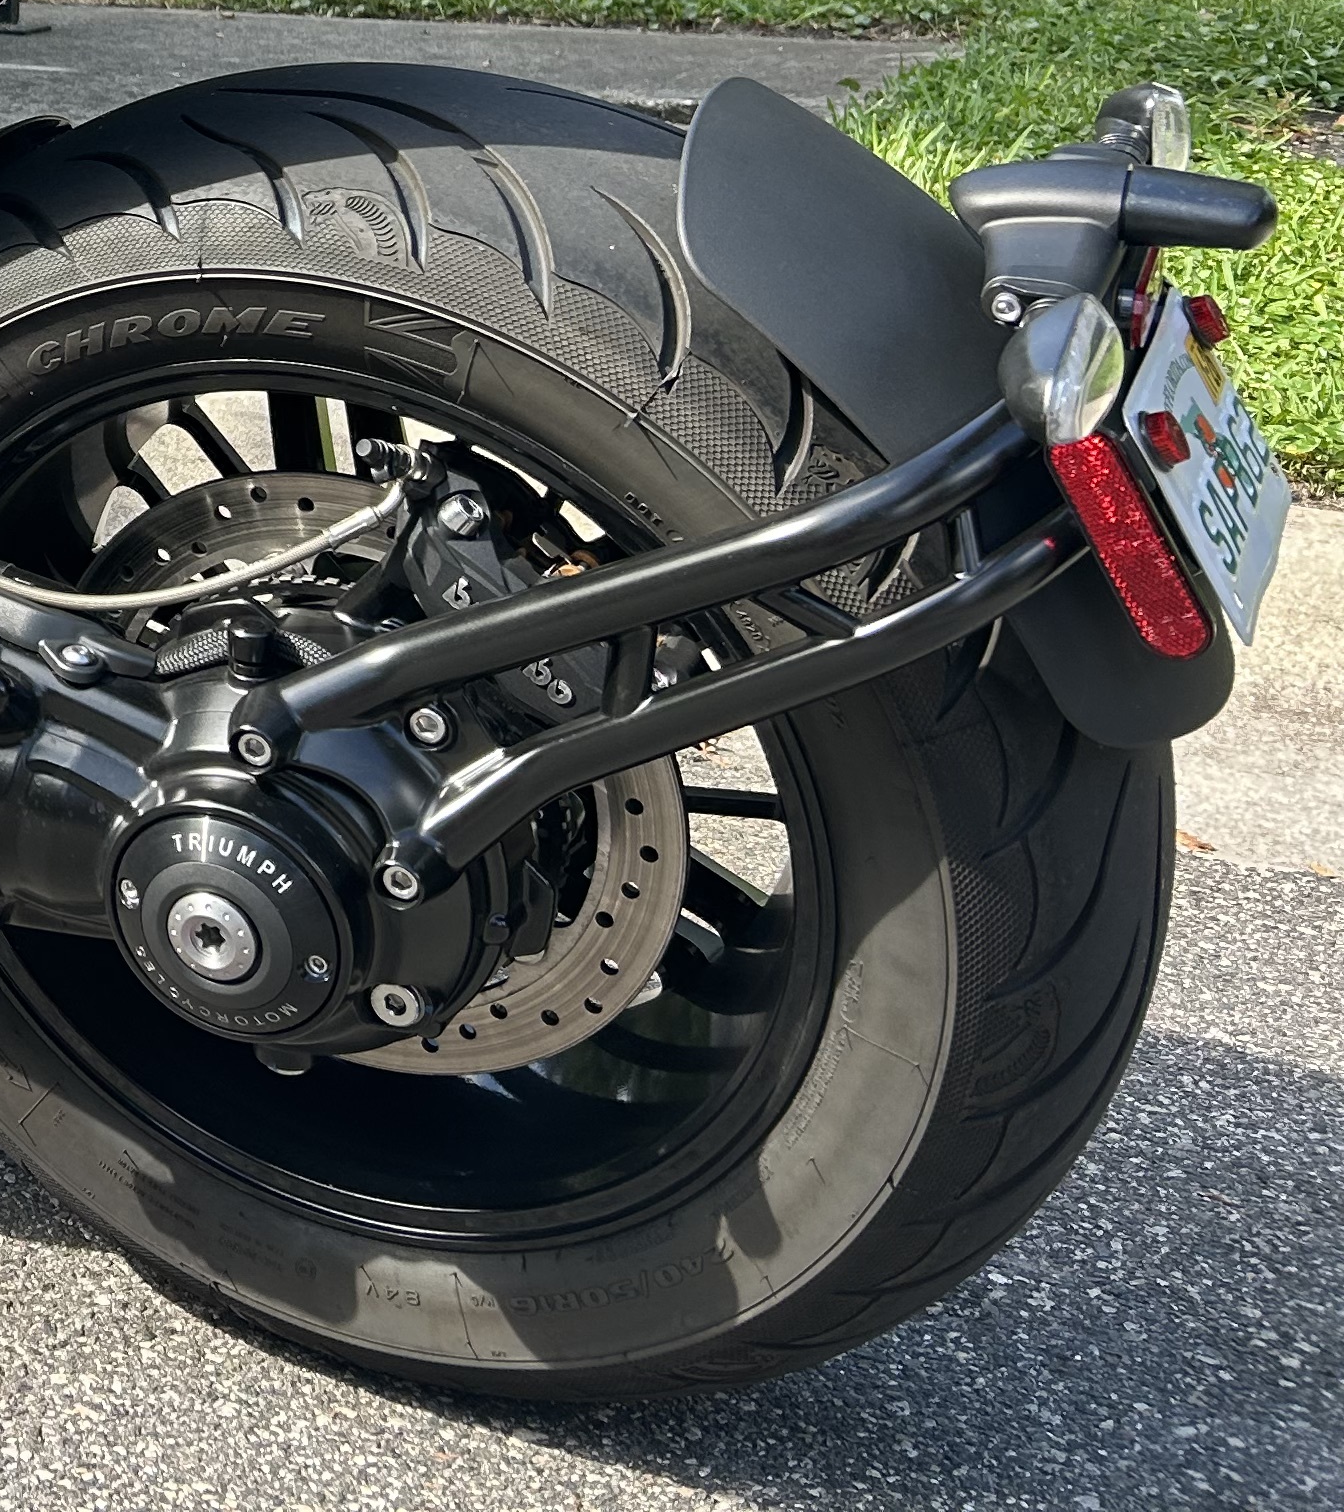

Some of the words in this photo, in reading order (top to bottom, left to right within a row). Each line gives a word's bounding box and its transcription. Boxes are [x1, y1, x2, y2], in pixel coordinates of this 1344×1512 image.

[25, 304, 327, 377] CHROME
[171, 832, 294, 894] TRIUMPH
[136, 945, 299, 1027] MOTORCYCLES
